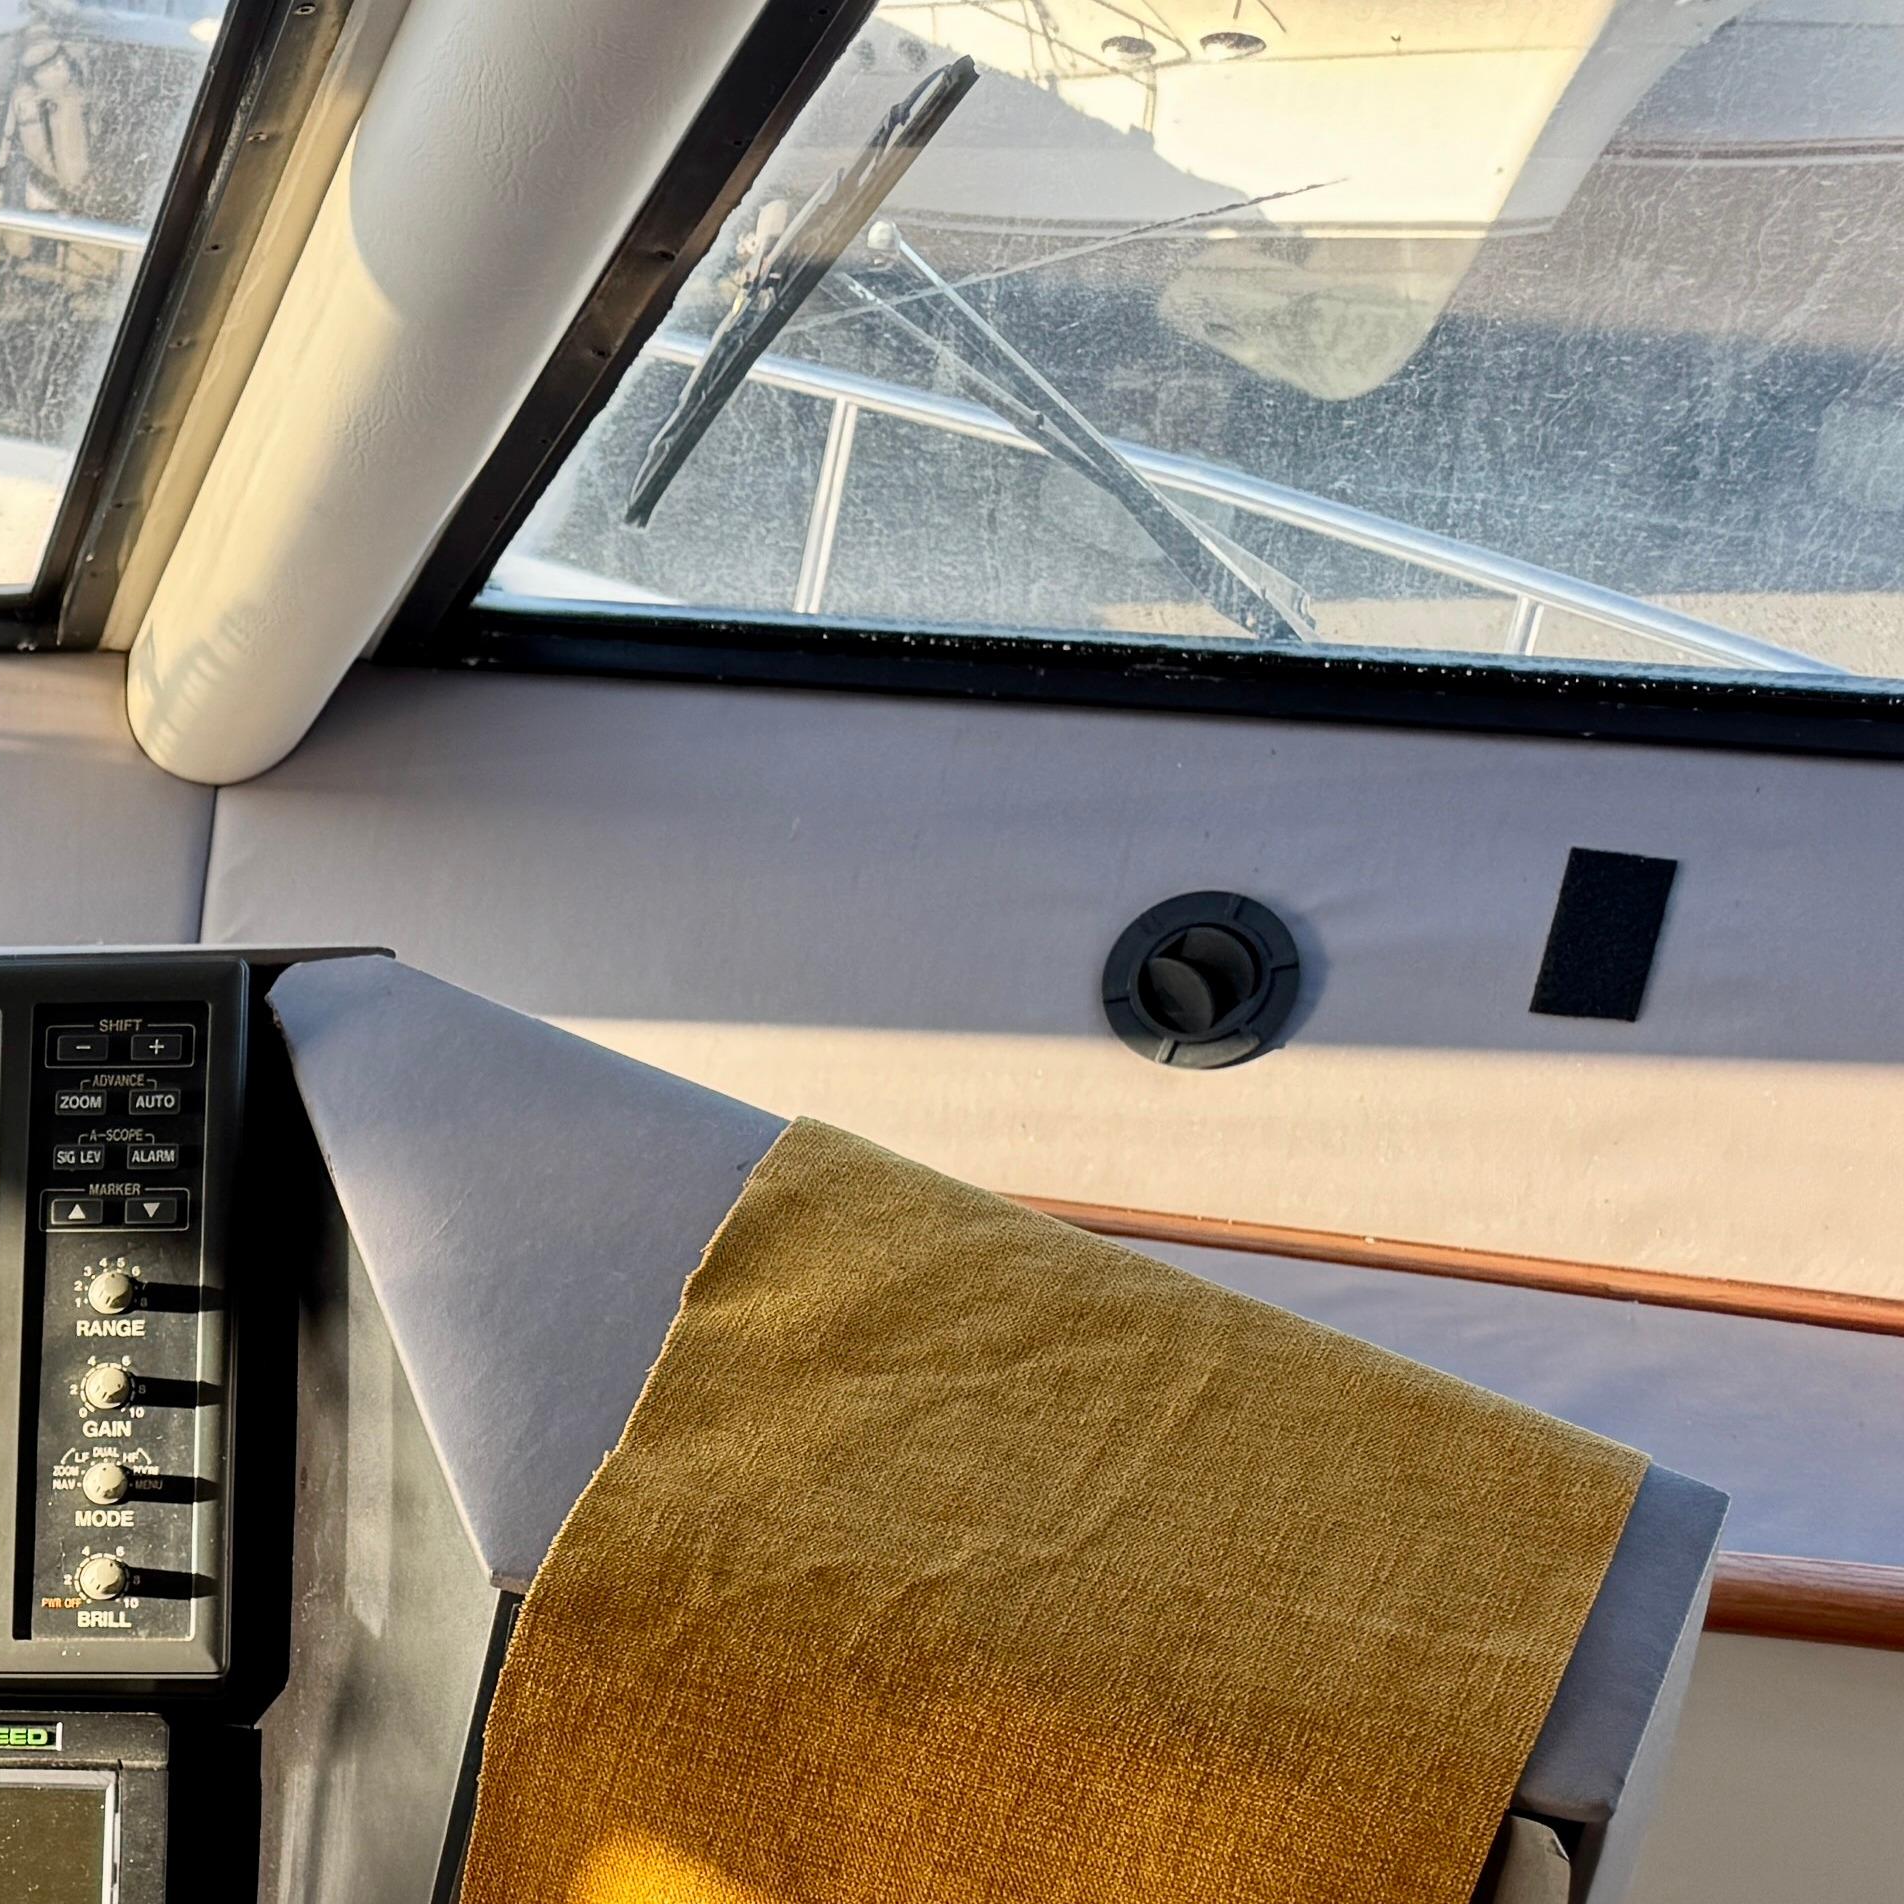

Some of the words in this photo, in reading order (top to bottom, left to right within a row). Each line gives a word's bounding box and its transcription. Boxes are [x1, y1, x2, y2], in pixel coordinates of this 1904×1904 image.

[99, 1018, 143, 1032] SHIFT
[92, 1074, 145, 1087] ADVANCE
[59, 1095, 102, 1109] ZOOM
[135, 1095, 175, 1109] AUTO
[89, 1128, 144, 1142] A-SCOPE
[56, 1150, 76, 1164] SIG
[80, 1150, 102, 1164] LEV
[131, 1149, 175, 1163] ALARM
[89, 1183, 141, 1196] MARKER
[99, 1257, 108, 1268] 4
[117, 1257, 126, 1268] 5
[83, 1265, 92, 1277] 3
[131, 1265, 141, 1277] 6
[73, 1280, 83, 1292] 2
[74, 1297, 81, 1308] 1
[76, 1319, 146, 1337] RANGE
[87, 1355, 97, 1366] 4
[121, 1355, 131, 1366] 6
[69, 1384, 79, 1395] 2
[78, 1408, 88, 1418] 0
[129, 1407, 145, 1418] 10
[82, 1420, 132, 1438] GAIN
[52, 1479, 76, 1490] NAV
[75, 1510, 135, 1527] MODE
[63, 1574, 73, 1585] 2
[123, 1598, 140, 1608] 10
[77, 1611, 132, 1628] BRILL
